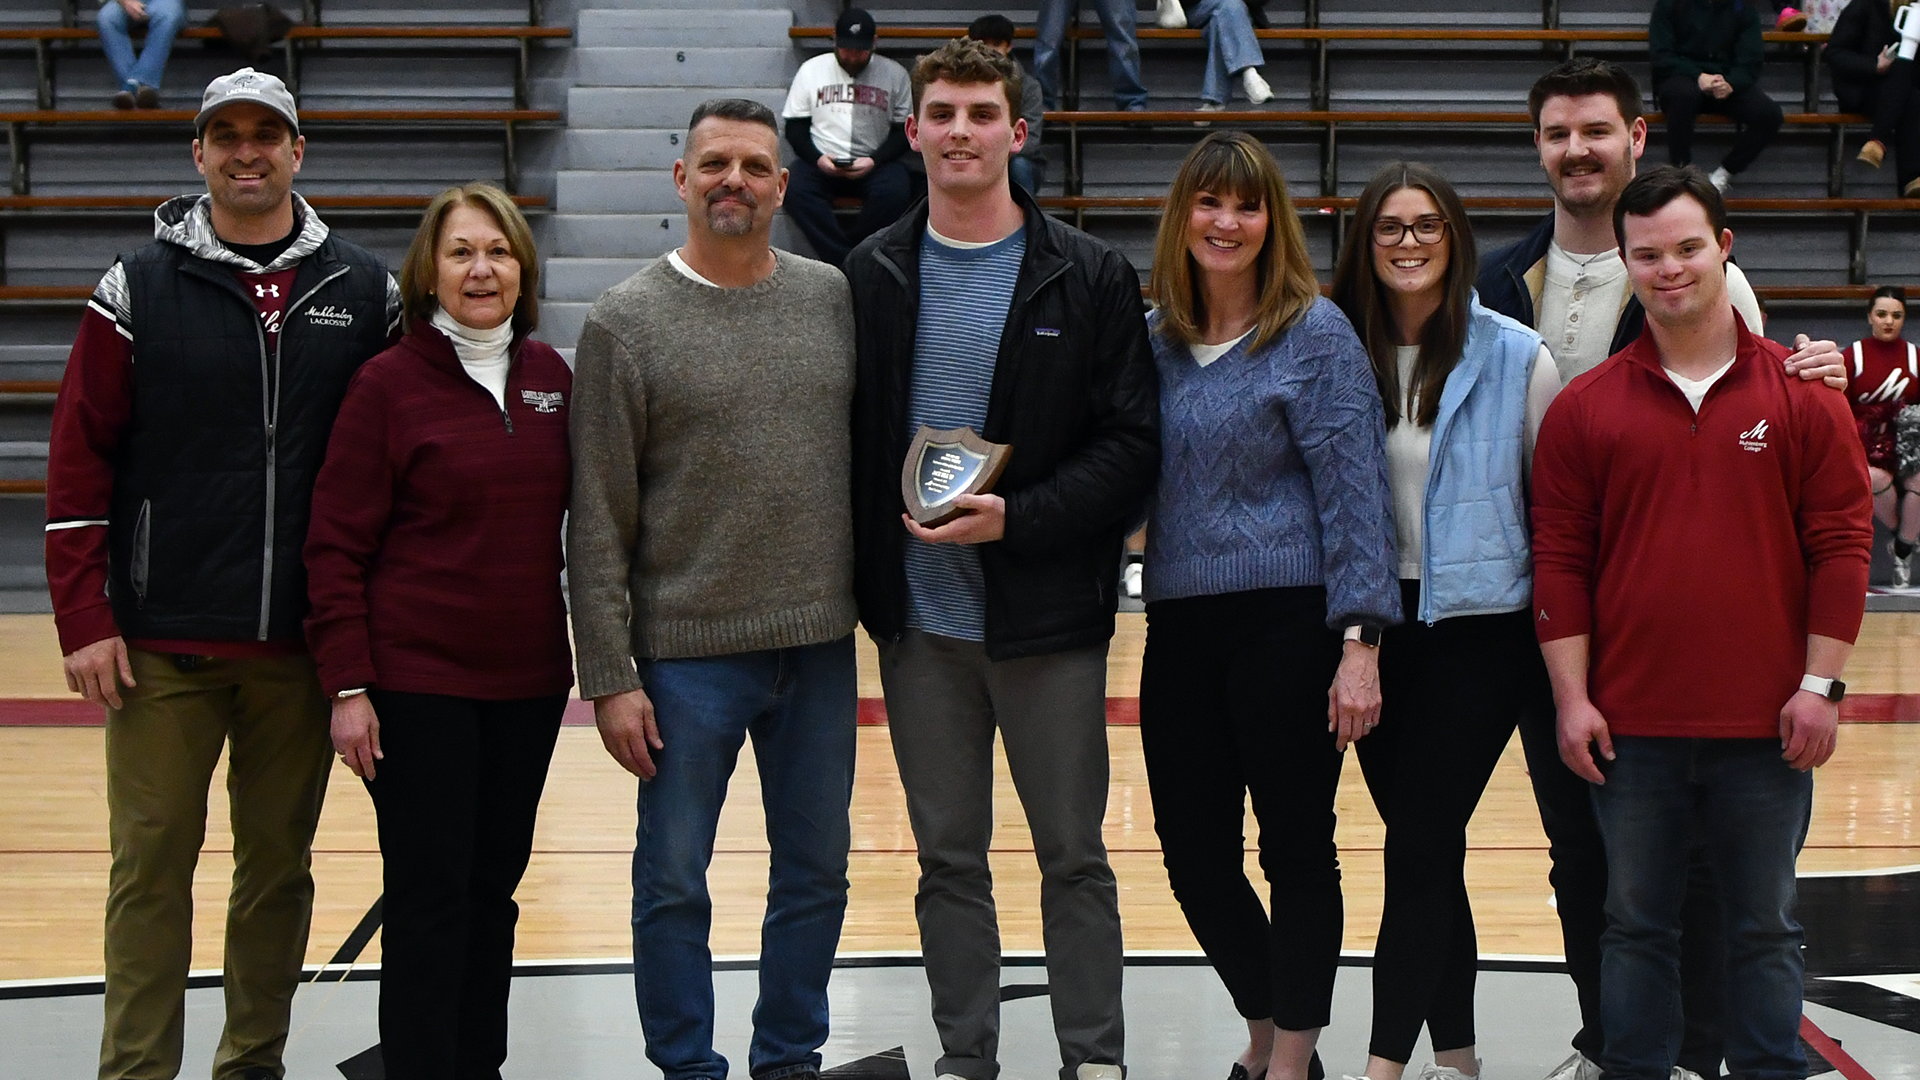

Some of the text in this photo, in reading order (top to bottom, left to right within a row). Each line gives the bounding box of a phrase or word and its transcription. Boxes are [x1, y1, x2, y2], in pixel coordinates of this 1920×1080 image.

[676, 51, 685, 62] 6
[815, 84, 888, 112] MUHLENBERG
[670, 133, 679, 145] 5
[660, 218, 670, 229] 4
[310, 317, 348, 327] LACROSSE
[1858, 367, 1910, 404] M
[1739, 419, 1769, 440] M
[1738, 439, 1768, 448] Muhlenberg
[1743, 445, 1762, 453] College
